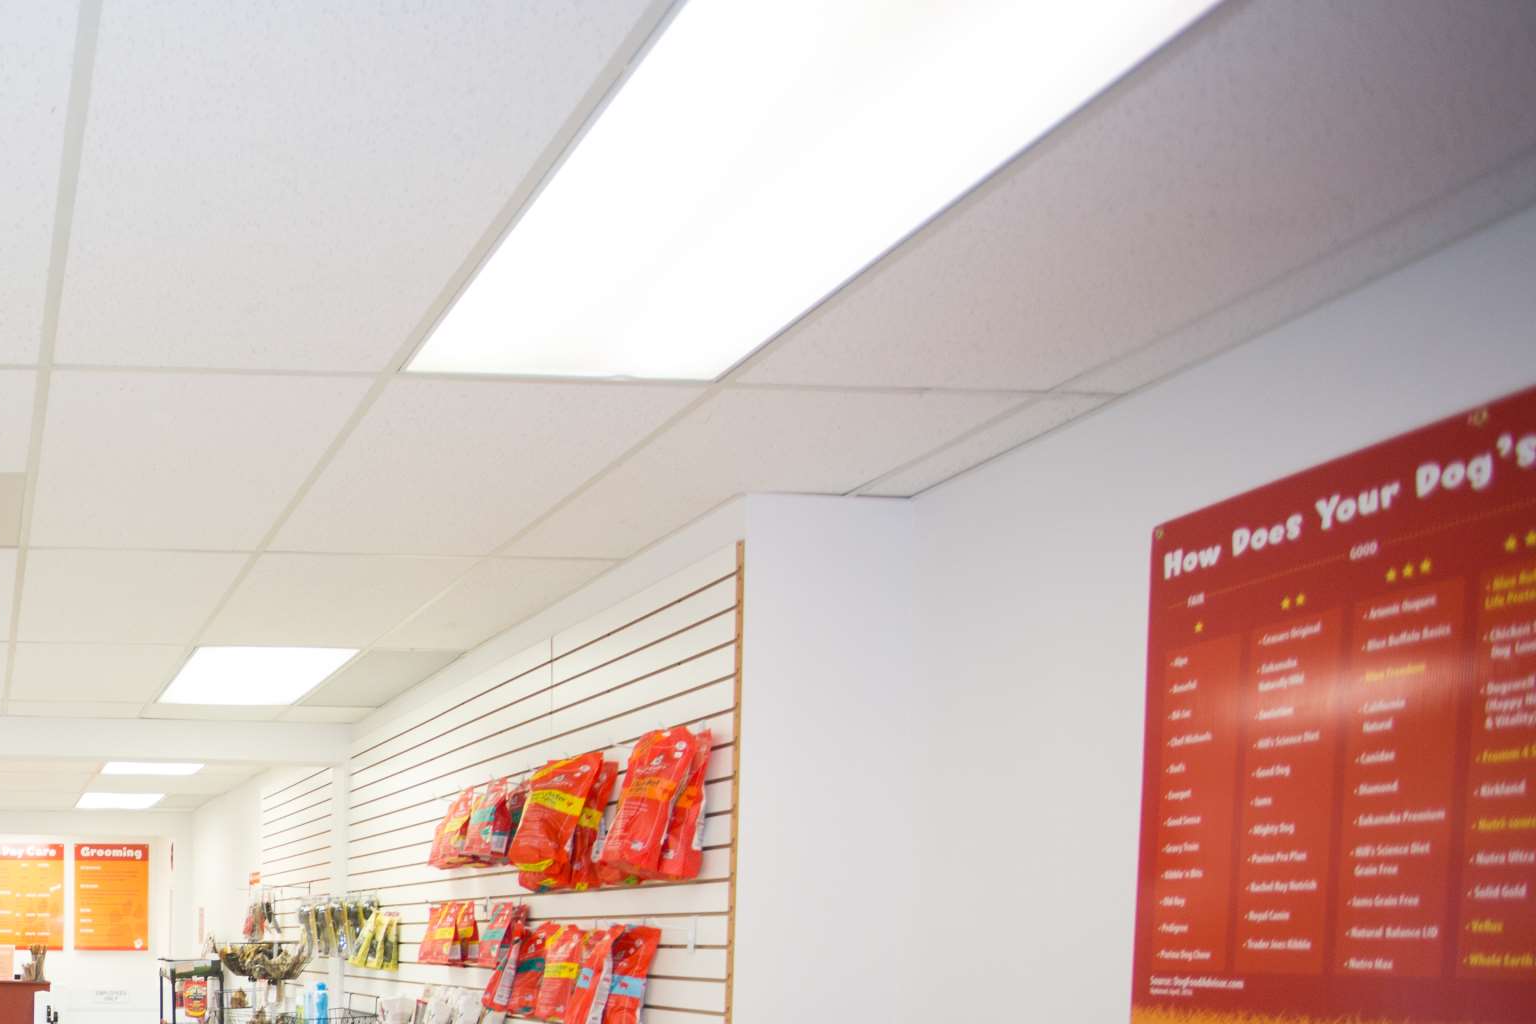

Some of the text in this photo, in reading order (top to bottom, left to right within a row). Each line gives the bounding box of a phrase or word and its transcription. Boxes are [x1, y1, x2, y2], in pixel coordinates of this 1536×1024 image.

[1164, 542, 1221, 580] How
[1232, 514, 1303, 557] Does
[1315, 481, 1400, 532] Your
[80, 846, 142, 860] Grooming
